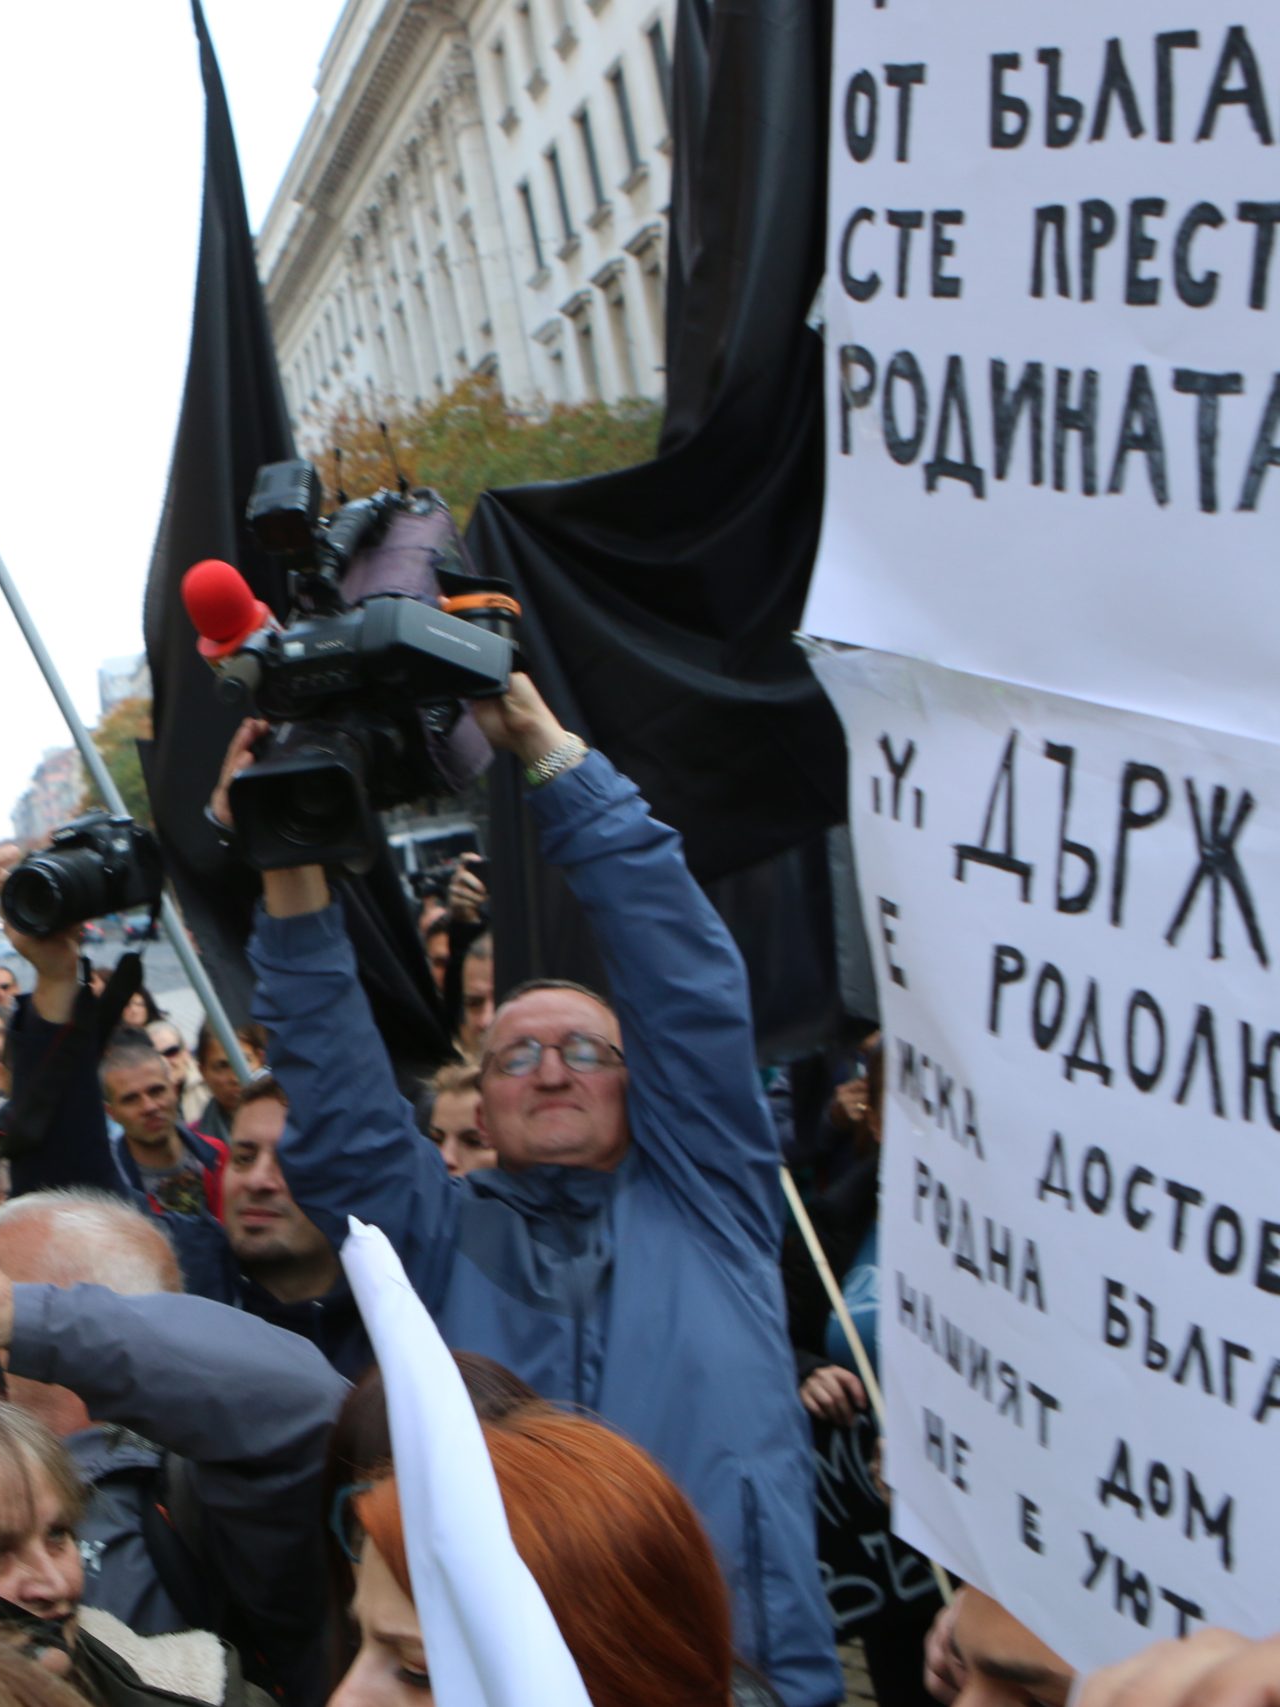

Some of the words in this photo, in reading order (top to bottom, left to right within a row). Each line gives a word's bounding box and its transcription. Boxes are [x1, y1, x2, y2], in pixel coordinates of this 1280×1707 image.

[842, 61, 928, 165] ОТ
[987, 24, 1276, 151] БЪЛГА
[837, 205, 967, 304] СТЕ
[1028, 195, 1280, 313] ПРЕСТ
[951, 727, 1273, 973] ДЪРЖ
[876, 894, 910, 991] Е
[986, 942, 1280, 1136] РОДОЛЮ
[914, 1156, 1047, 1314] РОДНА
[896, 1270, 1062, 1449] НАШИЯТ
[1096, 1437, 1237, 1573] ДОМ
[923, 1407, 971, 1495] НЕ
[1017, 1493, 1045, 1556] Е
[1080, 1529, 1207, 1643] УЮТ
